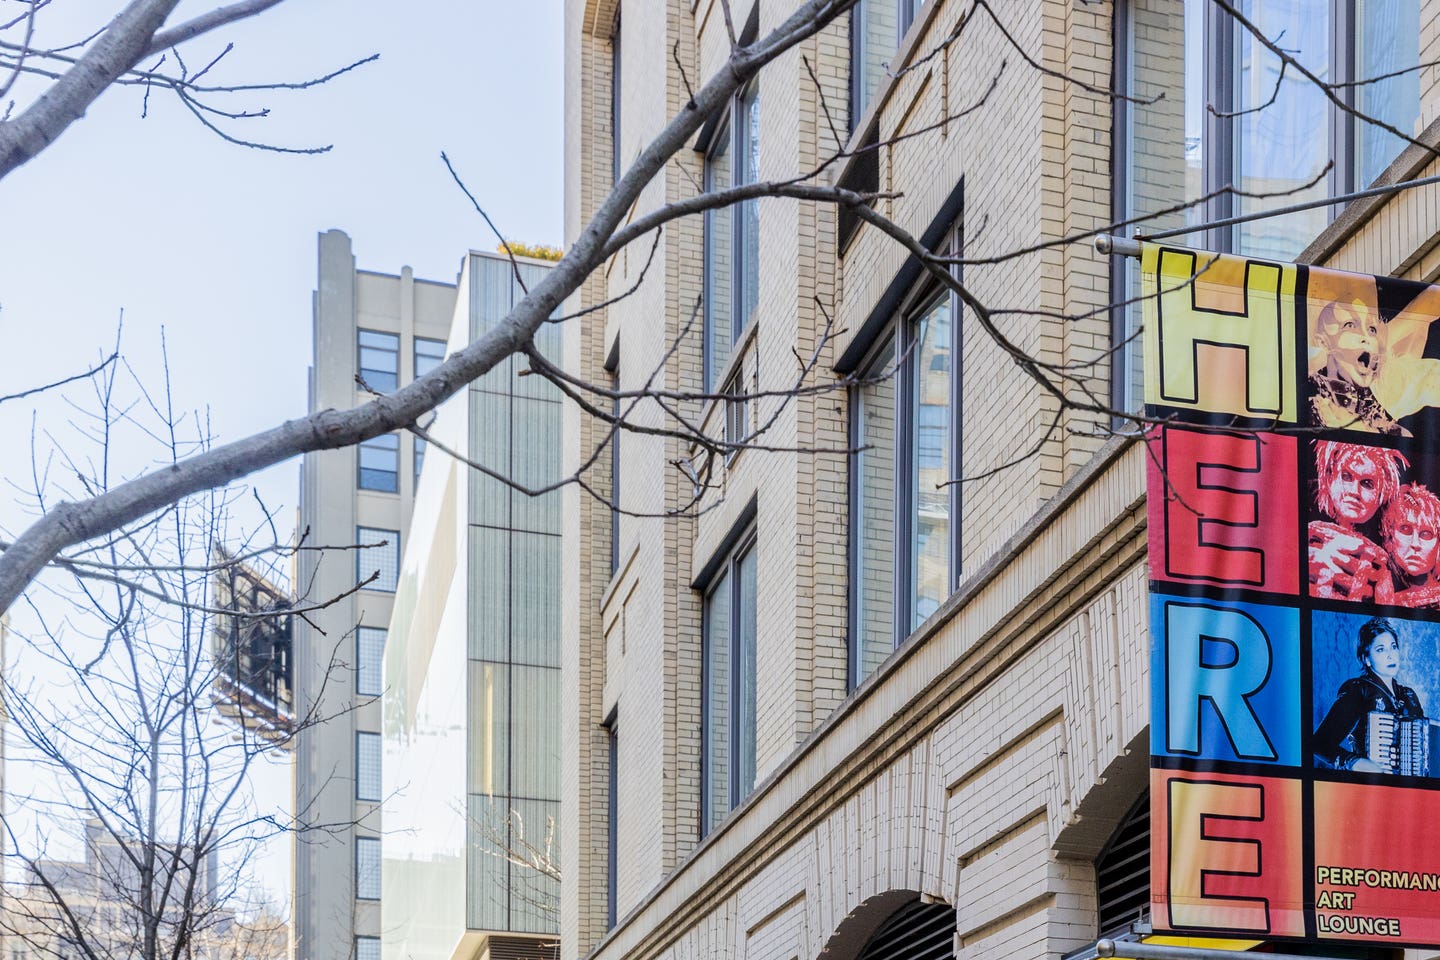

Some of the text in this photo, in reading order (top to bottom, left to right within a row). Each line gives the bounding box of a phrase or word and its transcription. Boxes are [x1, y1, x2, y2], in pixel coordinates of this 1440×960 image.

[1156, 247, 1283, 933] HERE
[1317, 891, 1355, 910] ART
[1319, 915, 1401, 936] LOUNGE
